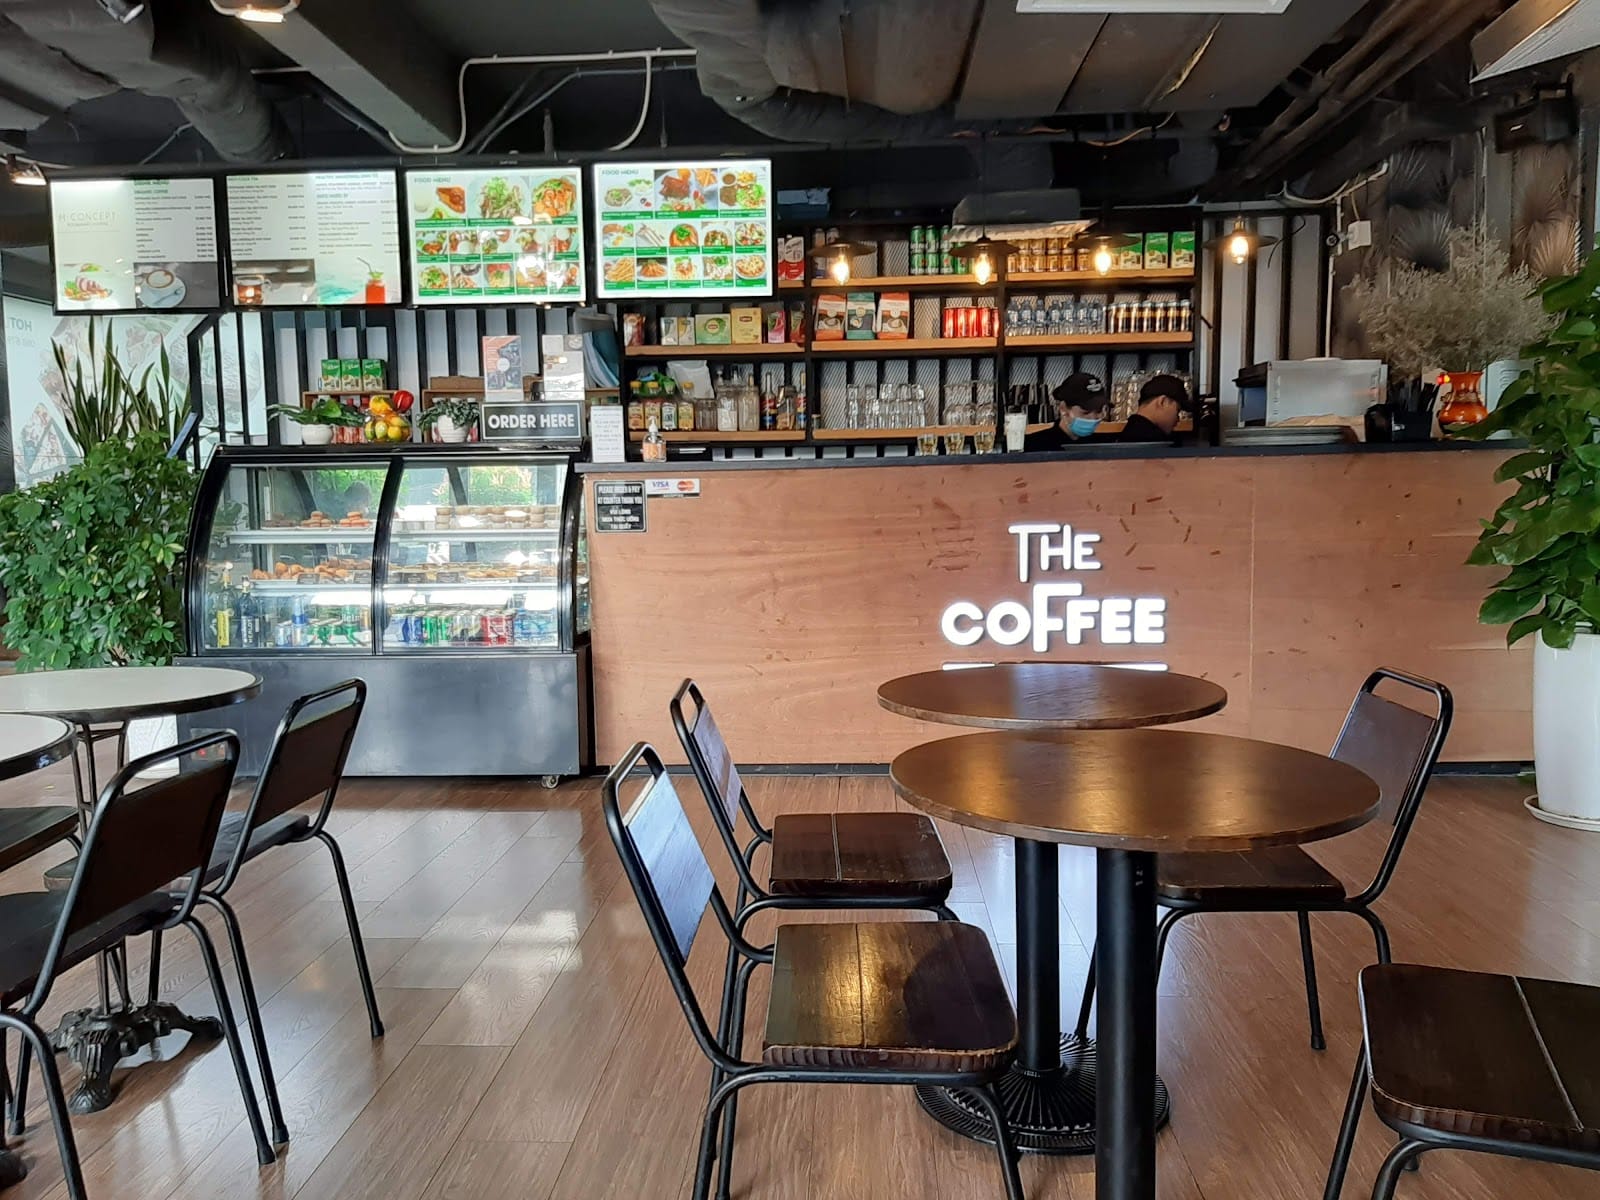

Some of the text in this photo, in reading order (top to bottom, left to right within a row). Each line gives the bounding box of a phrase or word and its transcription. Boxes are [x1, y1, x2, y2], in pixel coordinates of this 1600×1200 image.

[70, 210, 115, 222] CONCEPT
[488, 413, 575, 429] ORDER HERE
[1008, 523, 1102, 583] THE
[941, 582, 1166, 653] COFFEE
